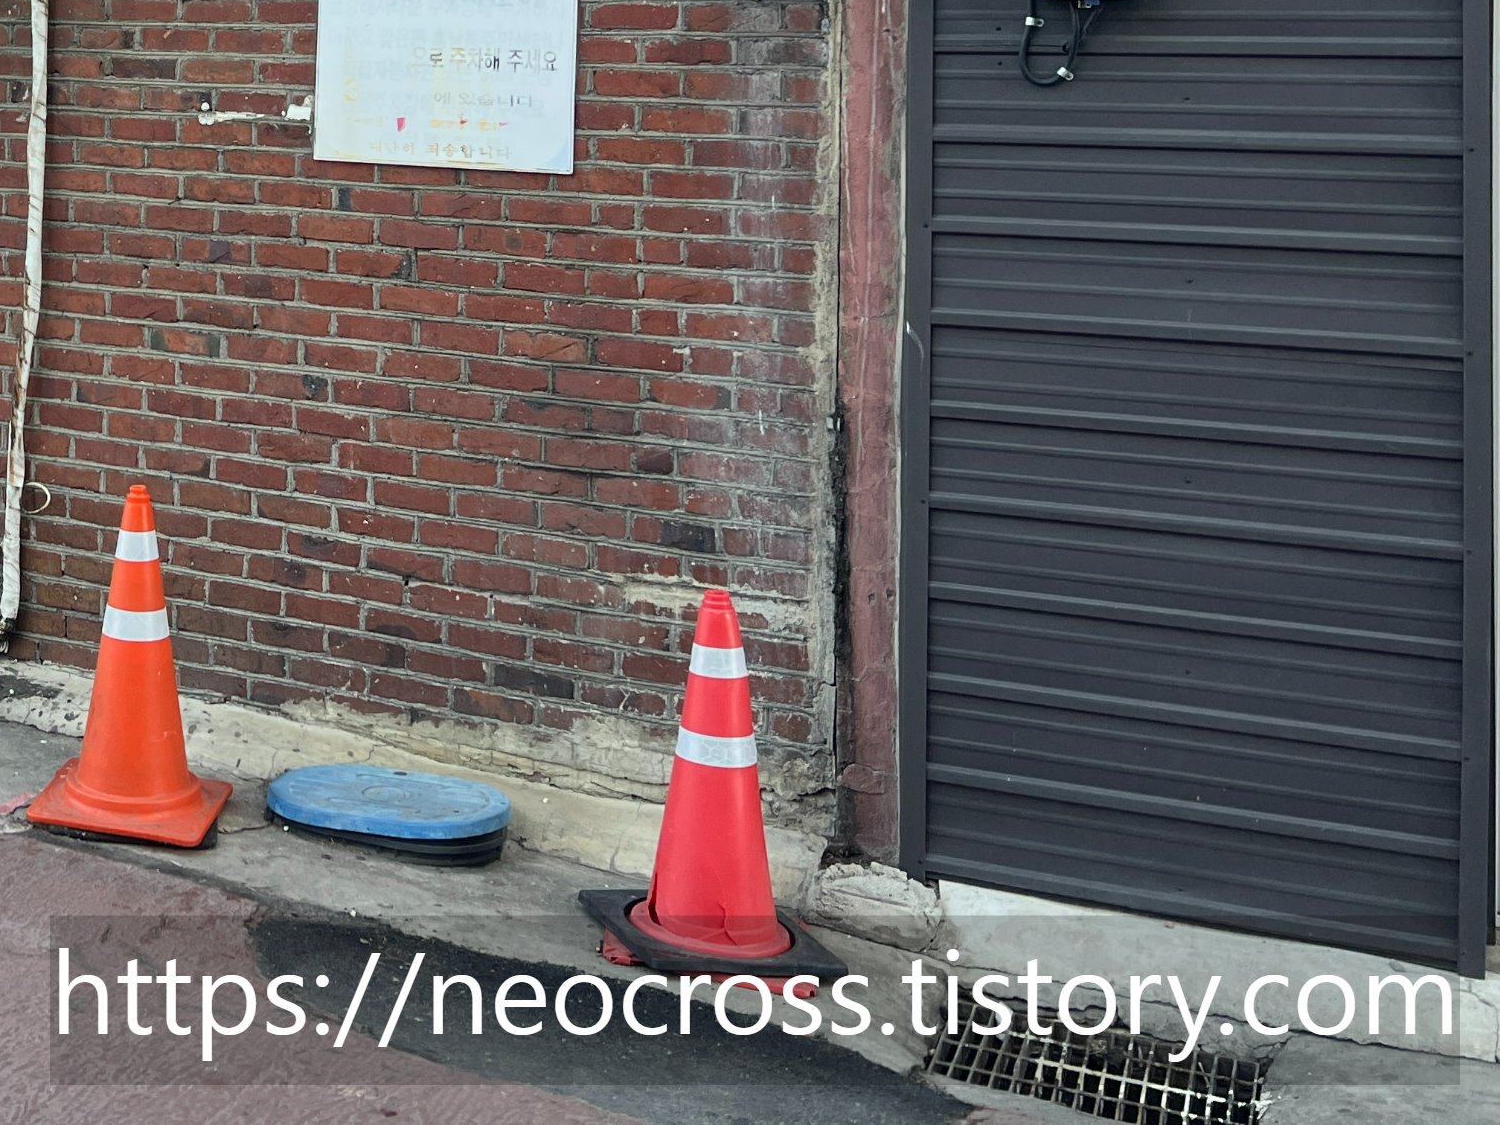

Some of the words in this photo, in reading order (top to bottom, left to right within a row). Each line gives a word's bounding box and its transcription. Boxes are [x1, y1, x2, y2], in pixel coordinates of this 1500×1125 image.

[449, 47, 501, 73] 주차해
[506, 49, 558, 75] 주세요
[425, 142, 512, 160] 죄송합니다
